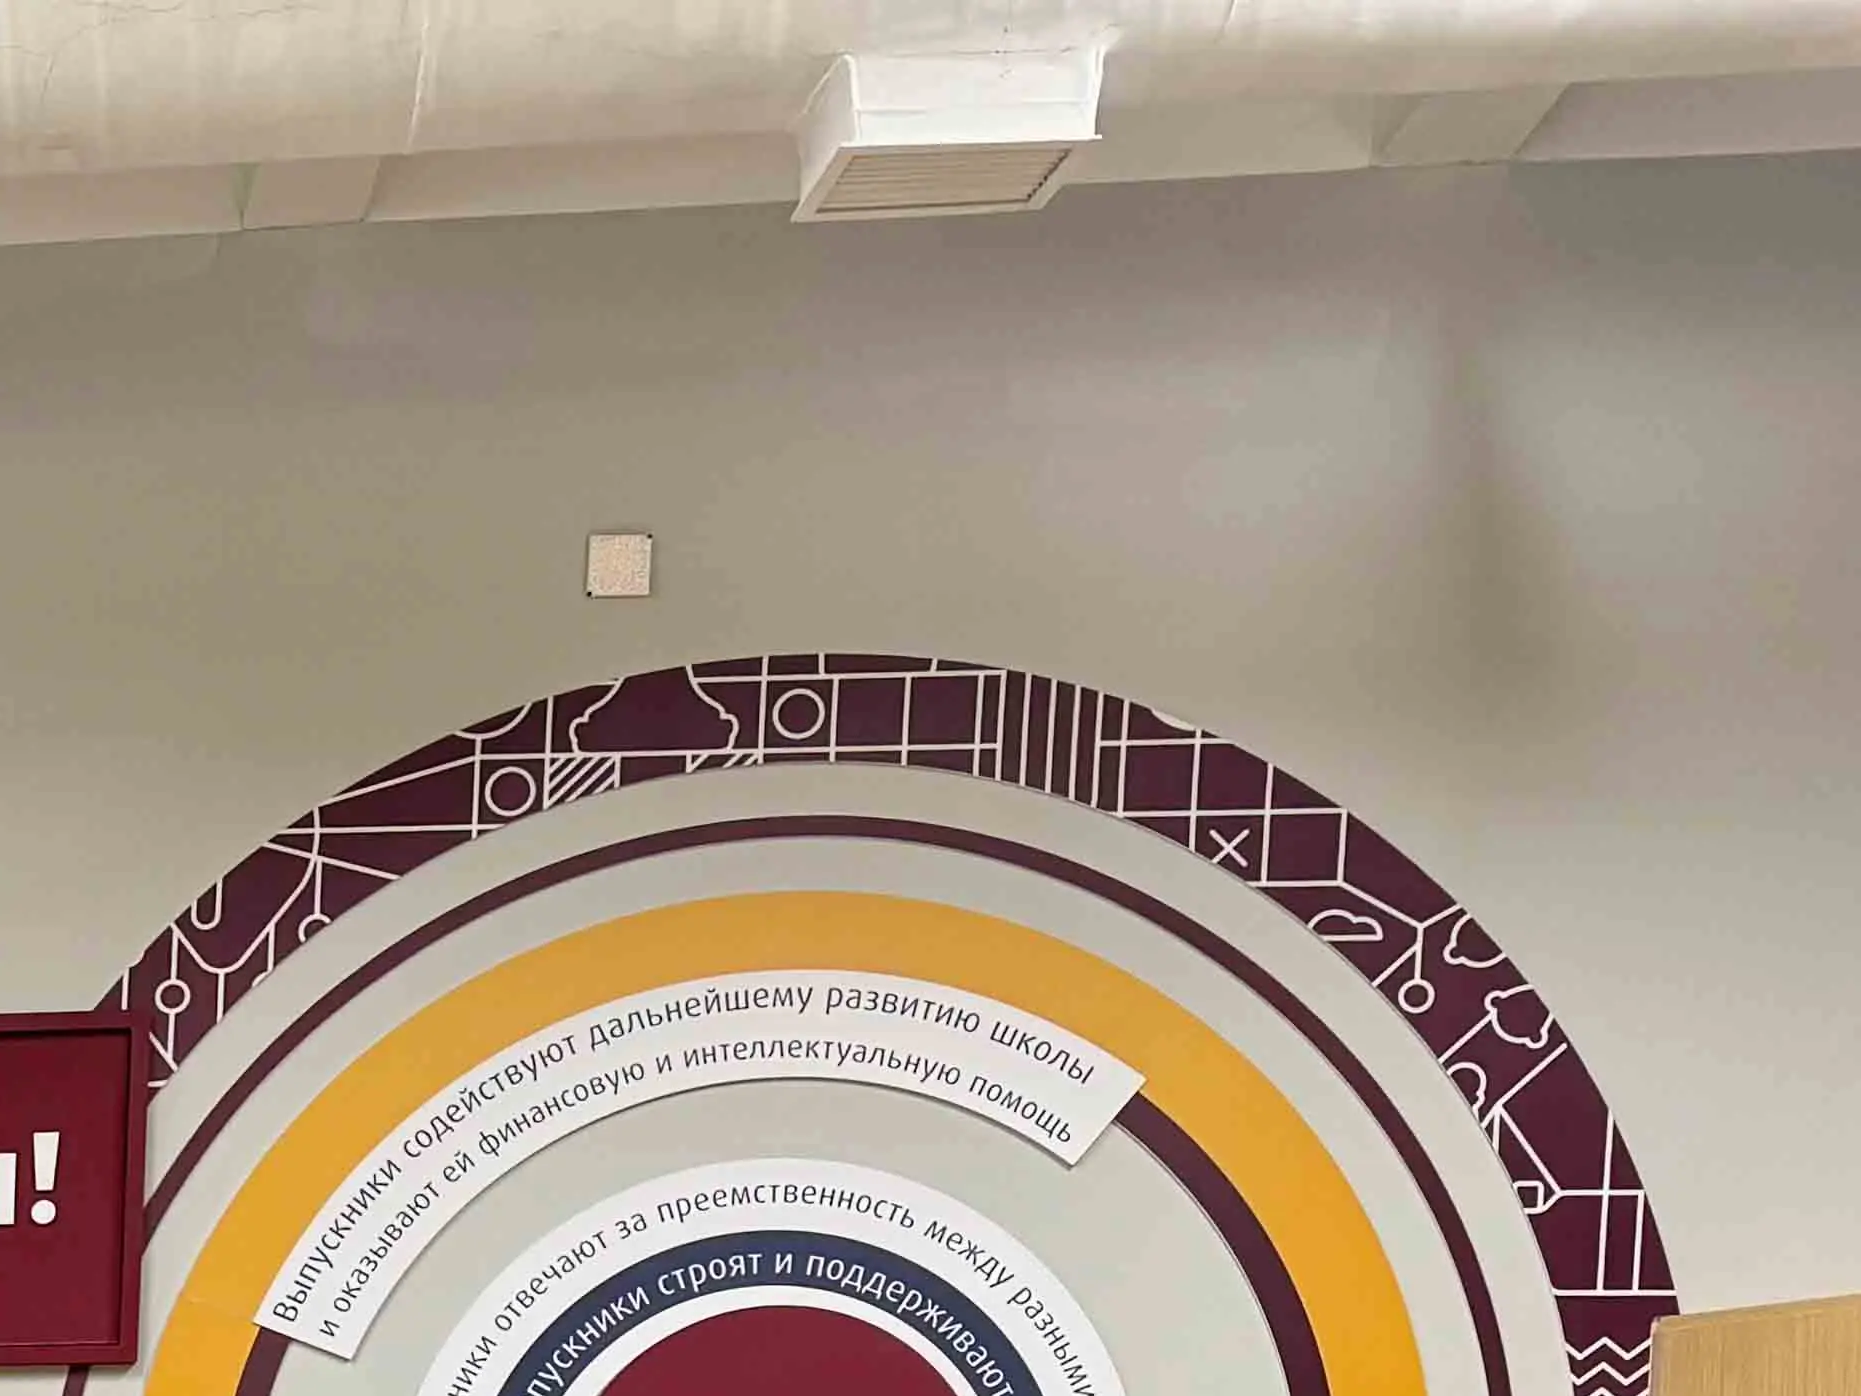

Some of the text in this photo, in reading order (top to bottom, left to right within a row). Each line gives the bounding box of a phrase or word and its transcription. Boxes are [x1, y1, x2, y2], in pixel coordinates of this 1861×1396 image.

[273, 984, 1095, 1322] Выпускники содействуют дальнейшему развитию школы
[319, 1038, 1072, 1338] и оказывают ей финансовую и интеллектуальную помощь
[494, 1231, 608, 1332] отвечают
[615, 1212, 647, 1240] за
[657, 1183, 914, 1230] преемственность
[924, 1219, 1014, 1288] между
[658, 1252, 762, 1296] строят
[775, 1253, 792, 1274] и
